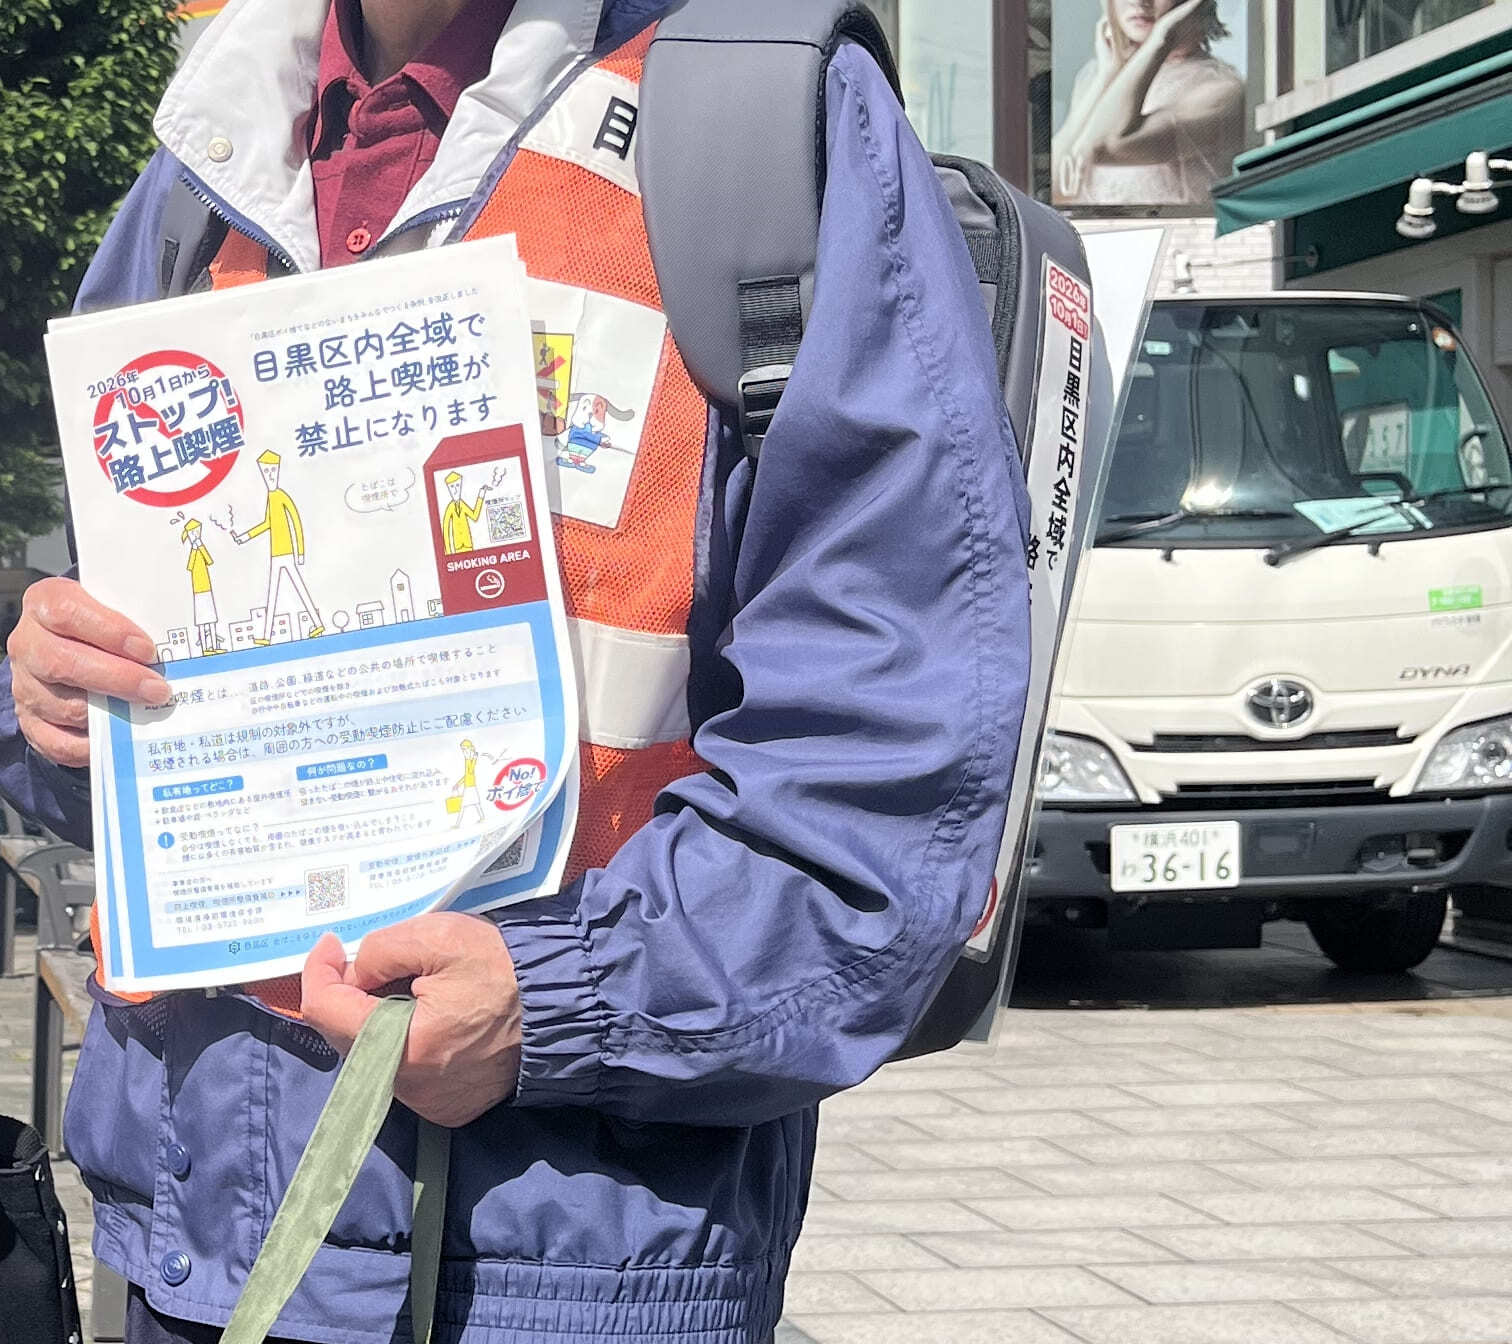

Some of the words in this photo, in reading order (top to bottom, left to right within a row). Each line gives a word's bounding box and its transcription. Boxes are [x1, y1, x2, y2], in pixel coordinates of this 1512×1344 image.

[593, 95, 638, 160] 目
[1050, 267, 1088, 312] 2026年
[253, 311, 486, 383] 目黒区内全域で
[86, 369, 140, 399] 2026年
[116, 364, 210, 409] 10月1日から
[323, 352, 490, 412] 路上喫煙が
[95, 378, 236, 457] ストップ！
[294, 392, 497, 458] 禁止になります
[108, 415, 246, 493] 路上喫煙
[1045, 336, 1083, 570] 目黒区内全域で
[447, 554, 498, 573] SMOKING
[499, 548, 531, 565] AREA
[1399, 664, 1472, 681] DYNA
[509, 766, 536, 782] No!
[1142, 851, 1231, 883] 36-16
